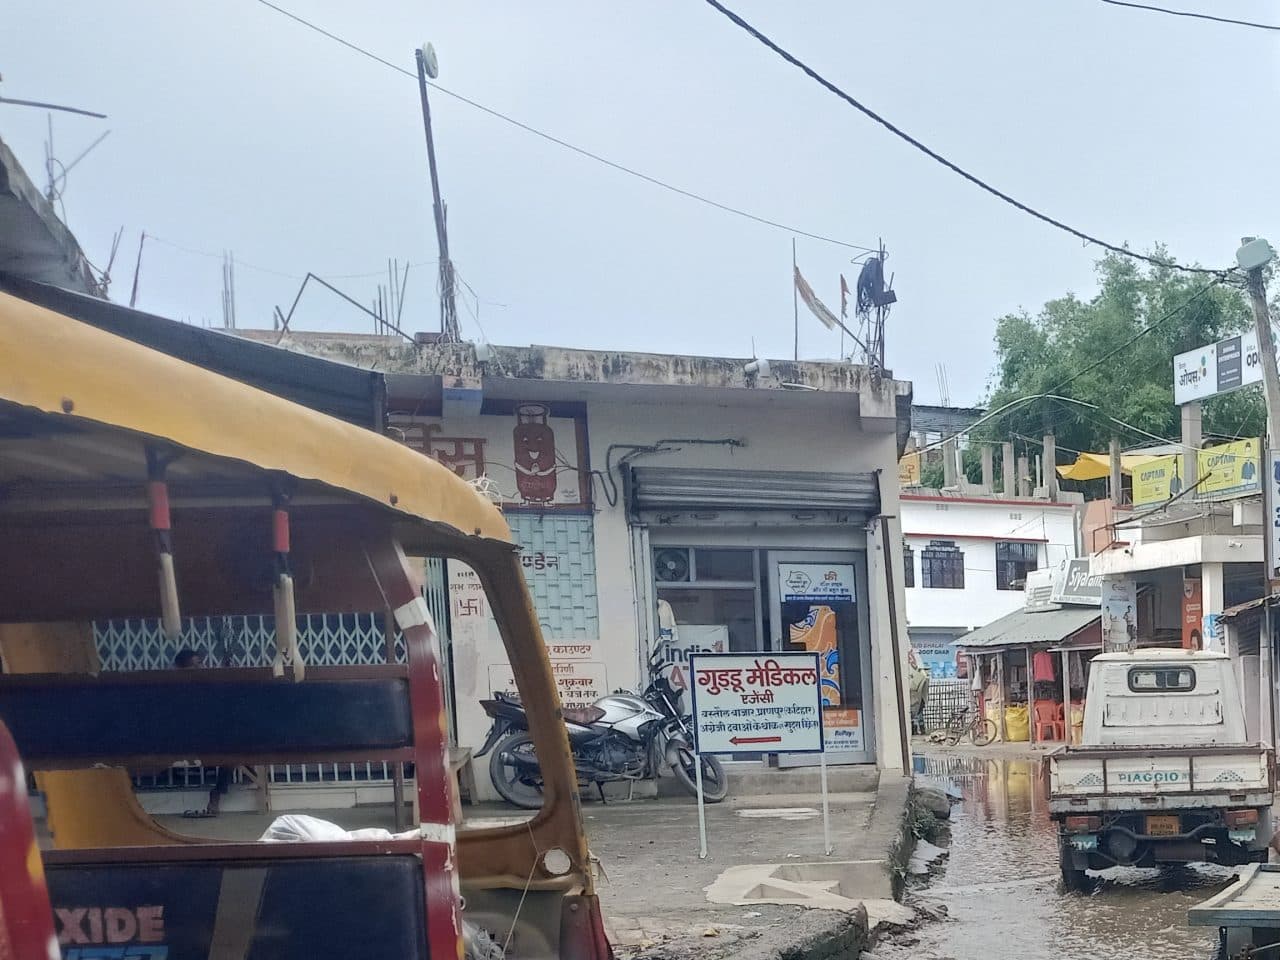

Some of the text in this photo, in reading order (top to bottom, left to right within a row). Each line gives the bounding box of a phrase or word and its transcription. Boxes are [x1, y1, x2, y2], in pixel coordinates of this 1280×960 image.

[665, 644, 712, 663] ind
[746, 659, 817, 687] मेडिकल
[558, 678, 593, 691] शुक्रवार
[740, 689, 774, 704] एजेंसी
[1118, 772, 1179, 783] PIAGGIO
[55, 905, 166, 945] XIDE
